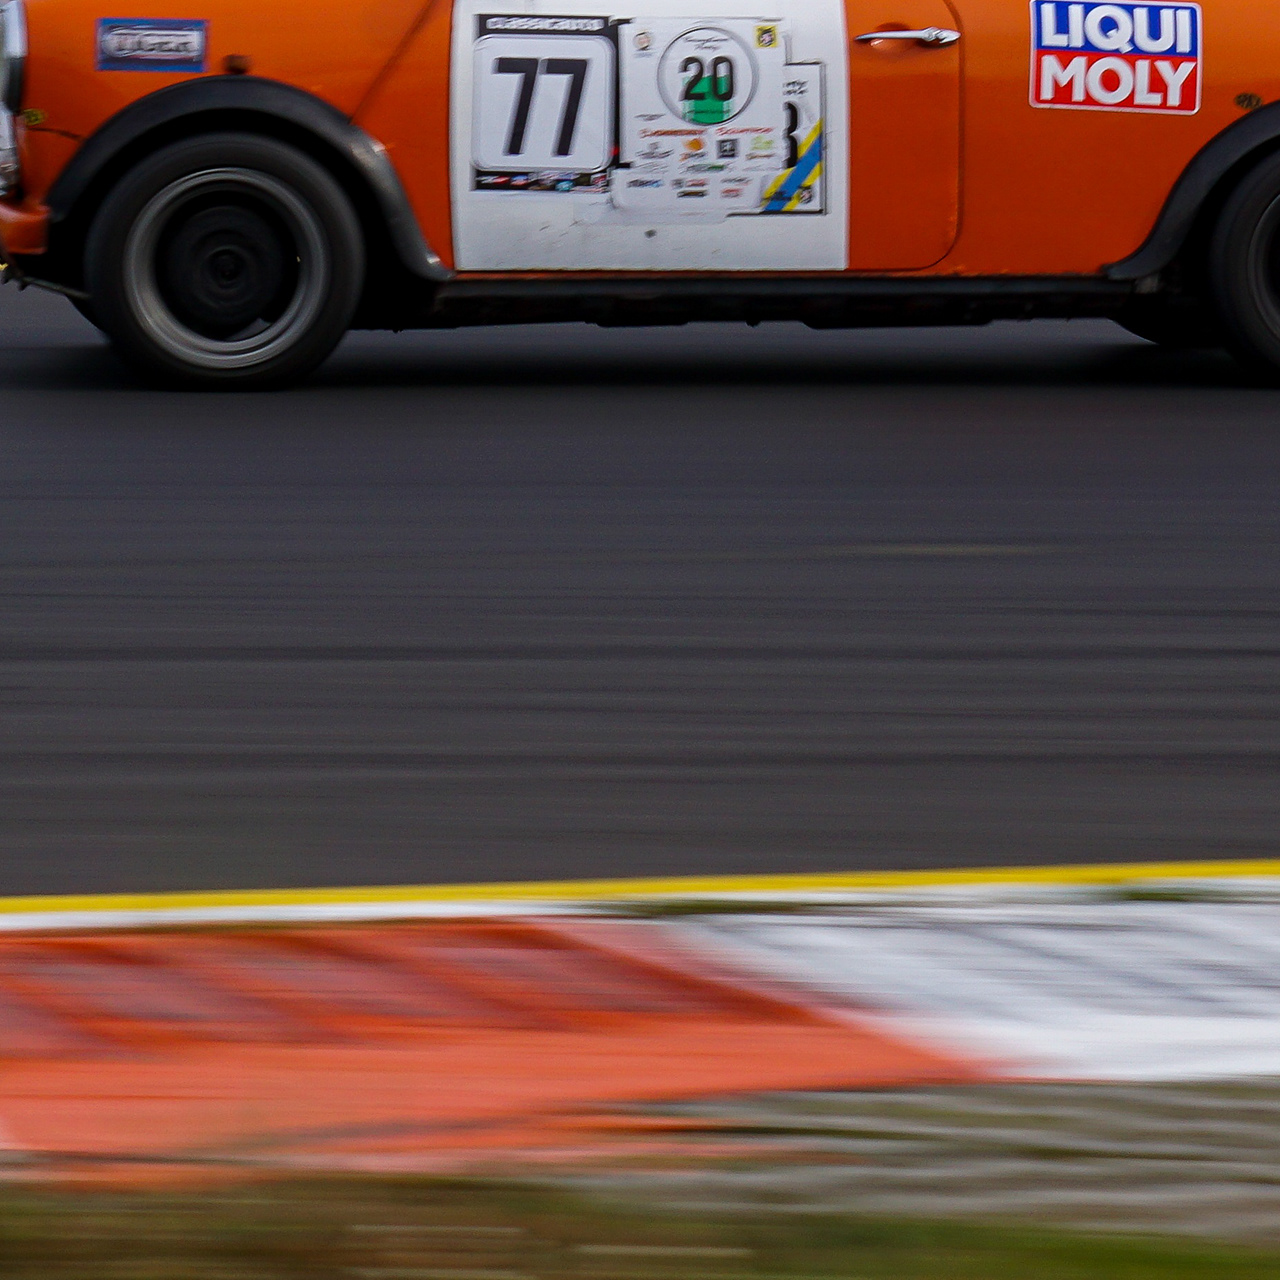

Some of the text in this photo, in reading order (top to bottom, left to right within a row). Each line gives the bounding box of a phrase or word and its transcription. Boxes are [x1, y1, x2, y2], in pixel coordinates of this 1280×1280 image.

[1040, 2, 1192, 54] LIQUI
[677, 55, 735, 102] 20
[1039, 54, 1197, 107] MOLY
[491, 57, 589, 156] 77
